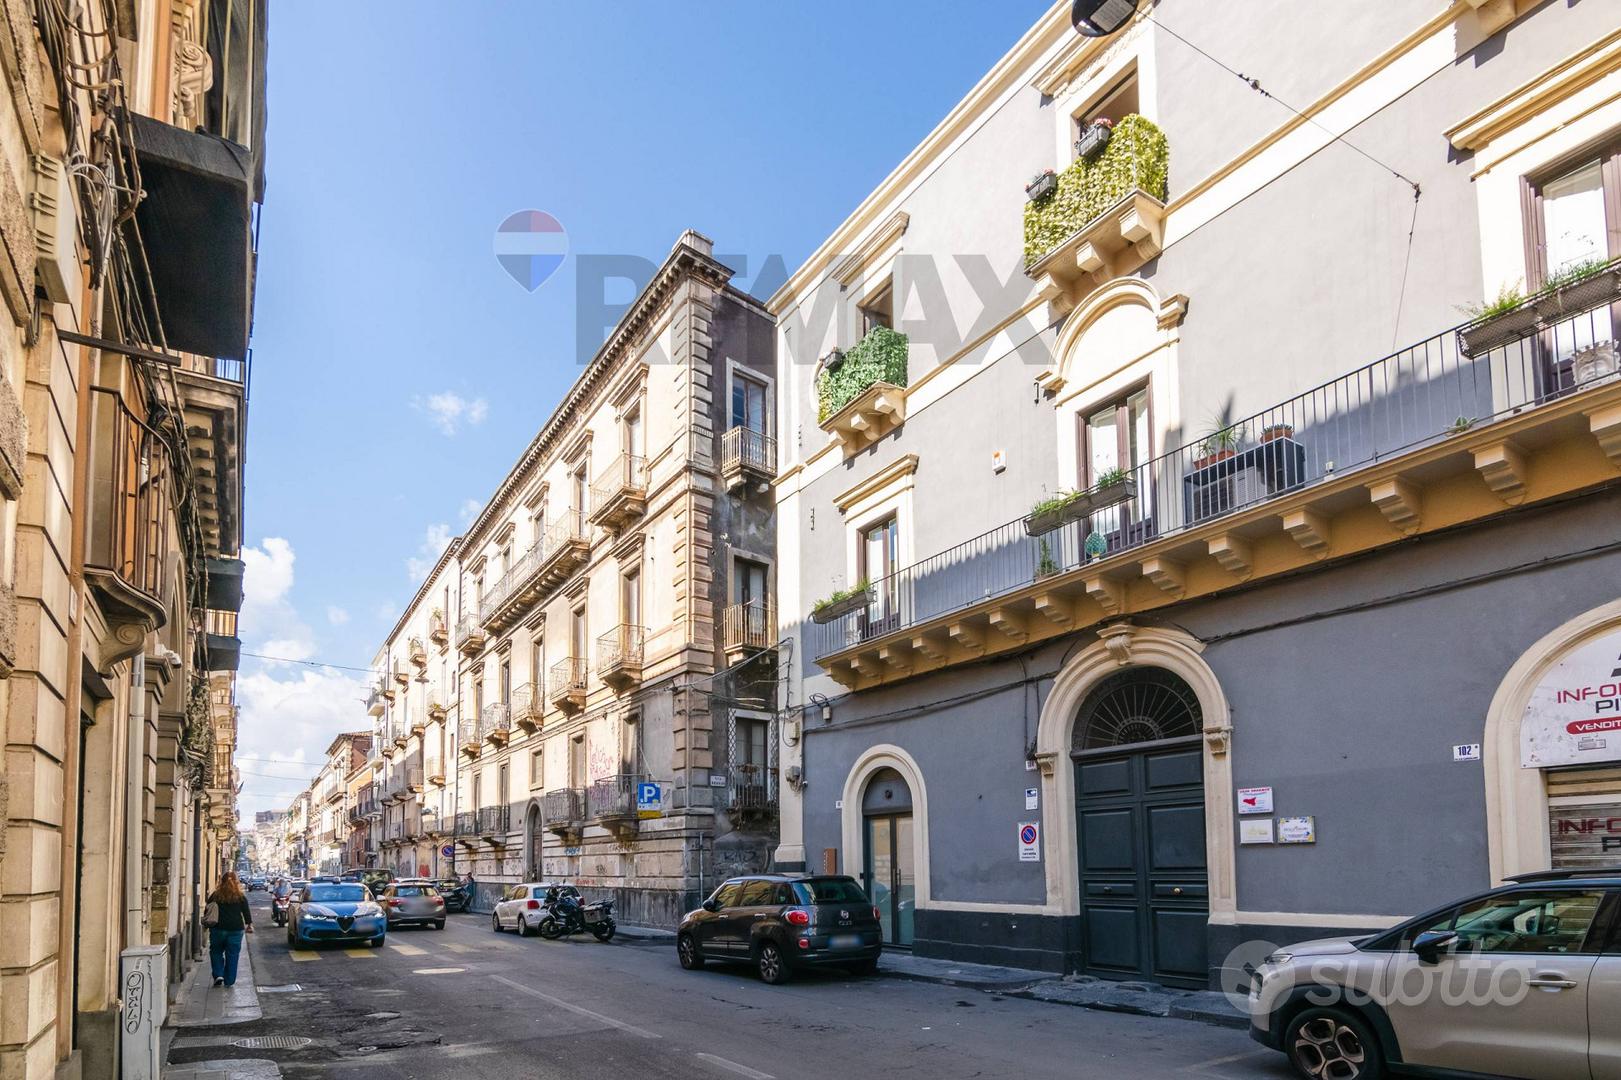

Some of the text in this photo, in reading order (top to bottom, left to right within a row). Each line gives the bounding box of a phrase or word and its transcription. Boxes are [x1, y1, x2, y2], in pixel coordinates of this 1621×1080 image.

[1557, 683, 1621, 704] INFO
[1458, 745, 1472, 756] 102
[643, 786, 656, 802] P
